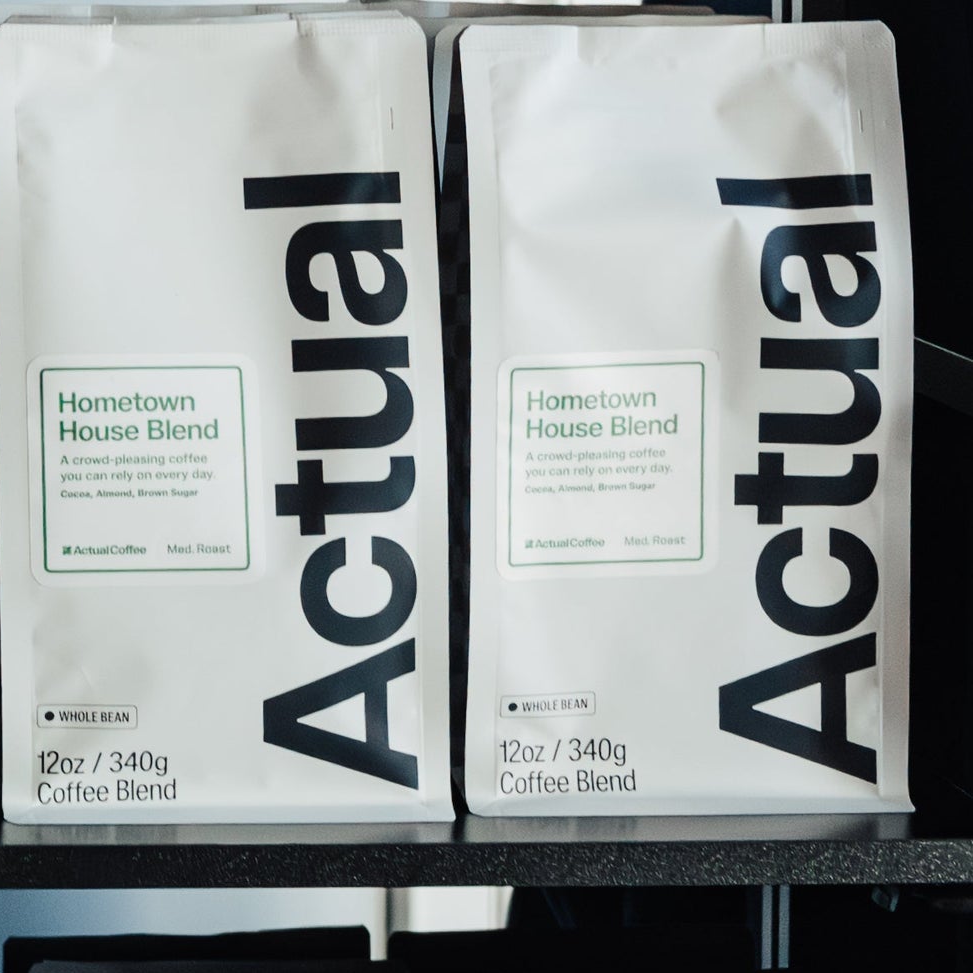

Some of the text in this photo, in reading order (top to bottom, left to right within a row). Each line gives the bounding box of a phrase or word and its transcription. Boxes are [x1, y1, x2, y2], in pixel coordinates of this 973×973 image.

[58, 391, 195, 414] Hometown
[527, 389, 657, 411] Hometown
[58, 418, 218, 442] House Blend
[526, 413, 678, 439] House Blend
[59, 452, 207, 467] A crowd-pleasing coffee
[59, 471, 82, 484] you
[85, 471, 108, 481] can
[110, 469, 133, 483] rely
[136, 471, 152, 481] on
[154, 471, 188, 481] every
[243, 172, 418, 789] Actual
[716, 174, 881, 785] Actual
[196, 543, 231, 554] Roast
[58, 710, 130, 723] WHOLE BEAN
[521, 697, 588, 712] WHOLE BEAN
[37, 750, 85, 775] 12oz
[109, 750, 168, 776] 340g
[499, 739, 544, 763] 12oz
[568, 737, 626, 767] 340g
[36, 777, 176, 804] Coffee Blend
[500, 768, 637, 794] Coffee Blend
